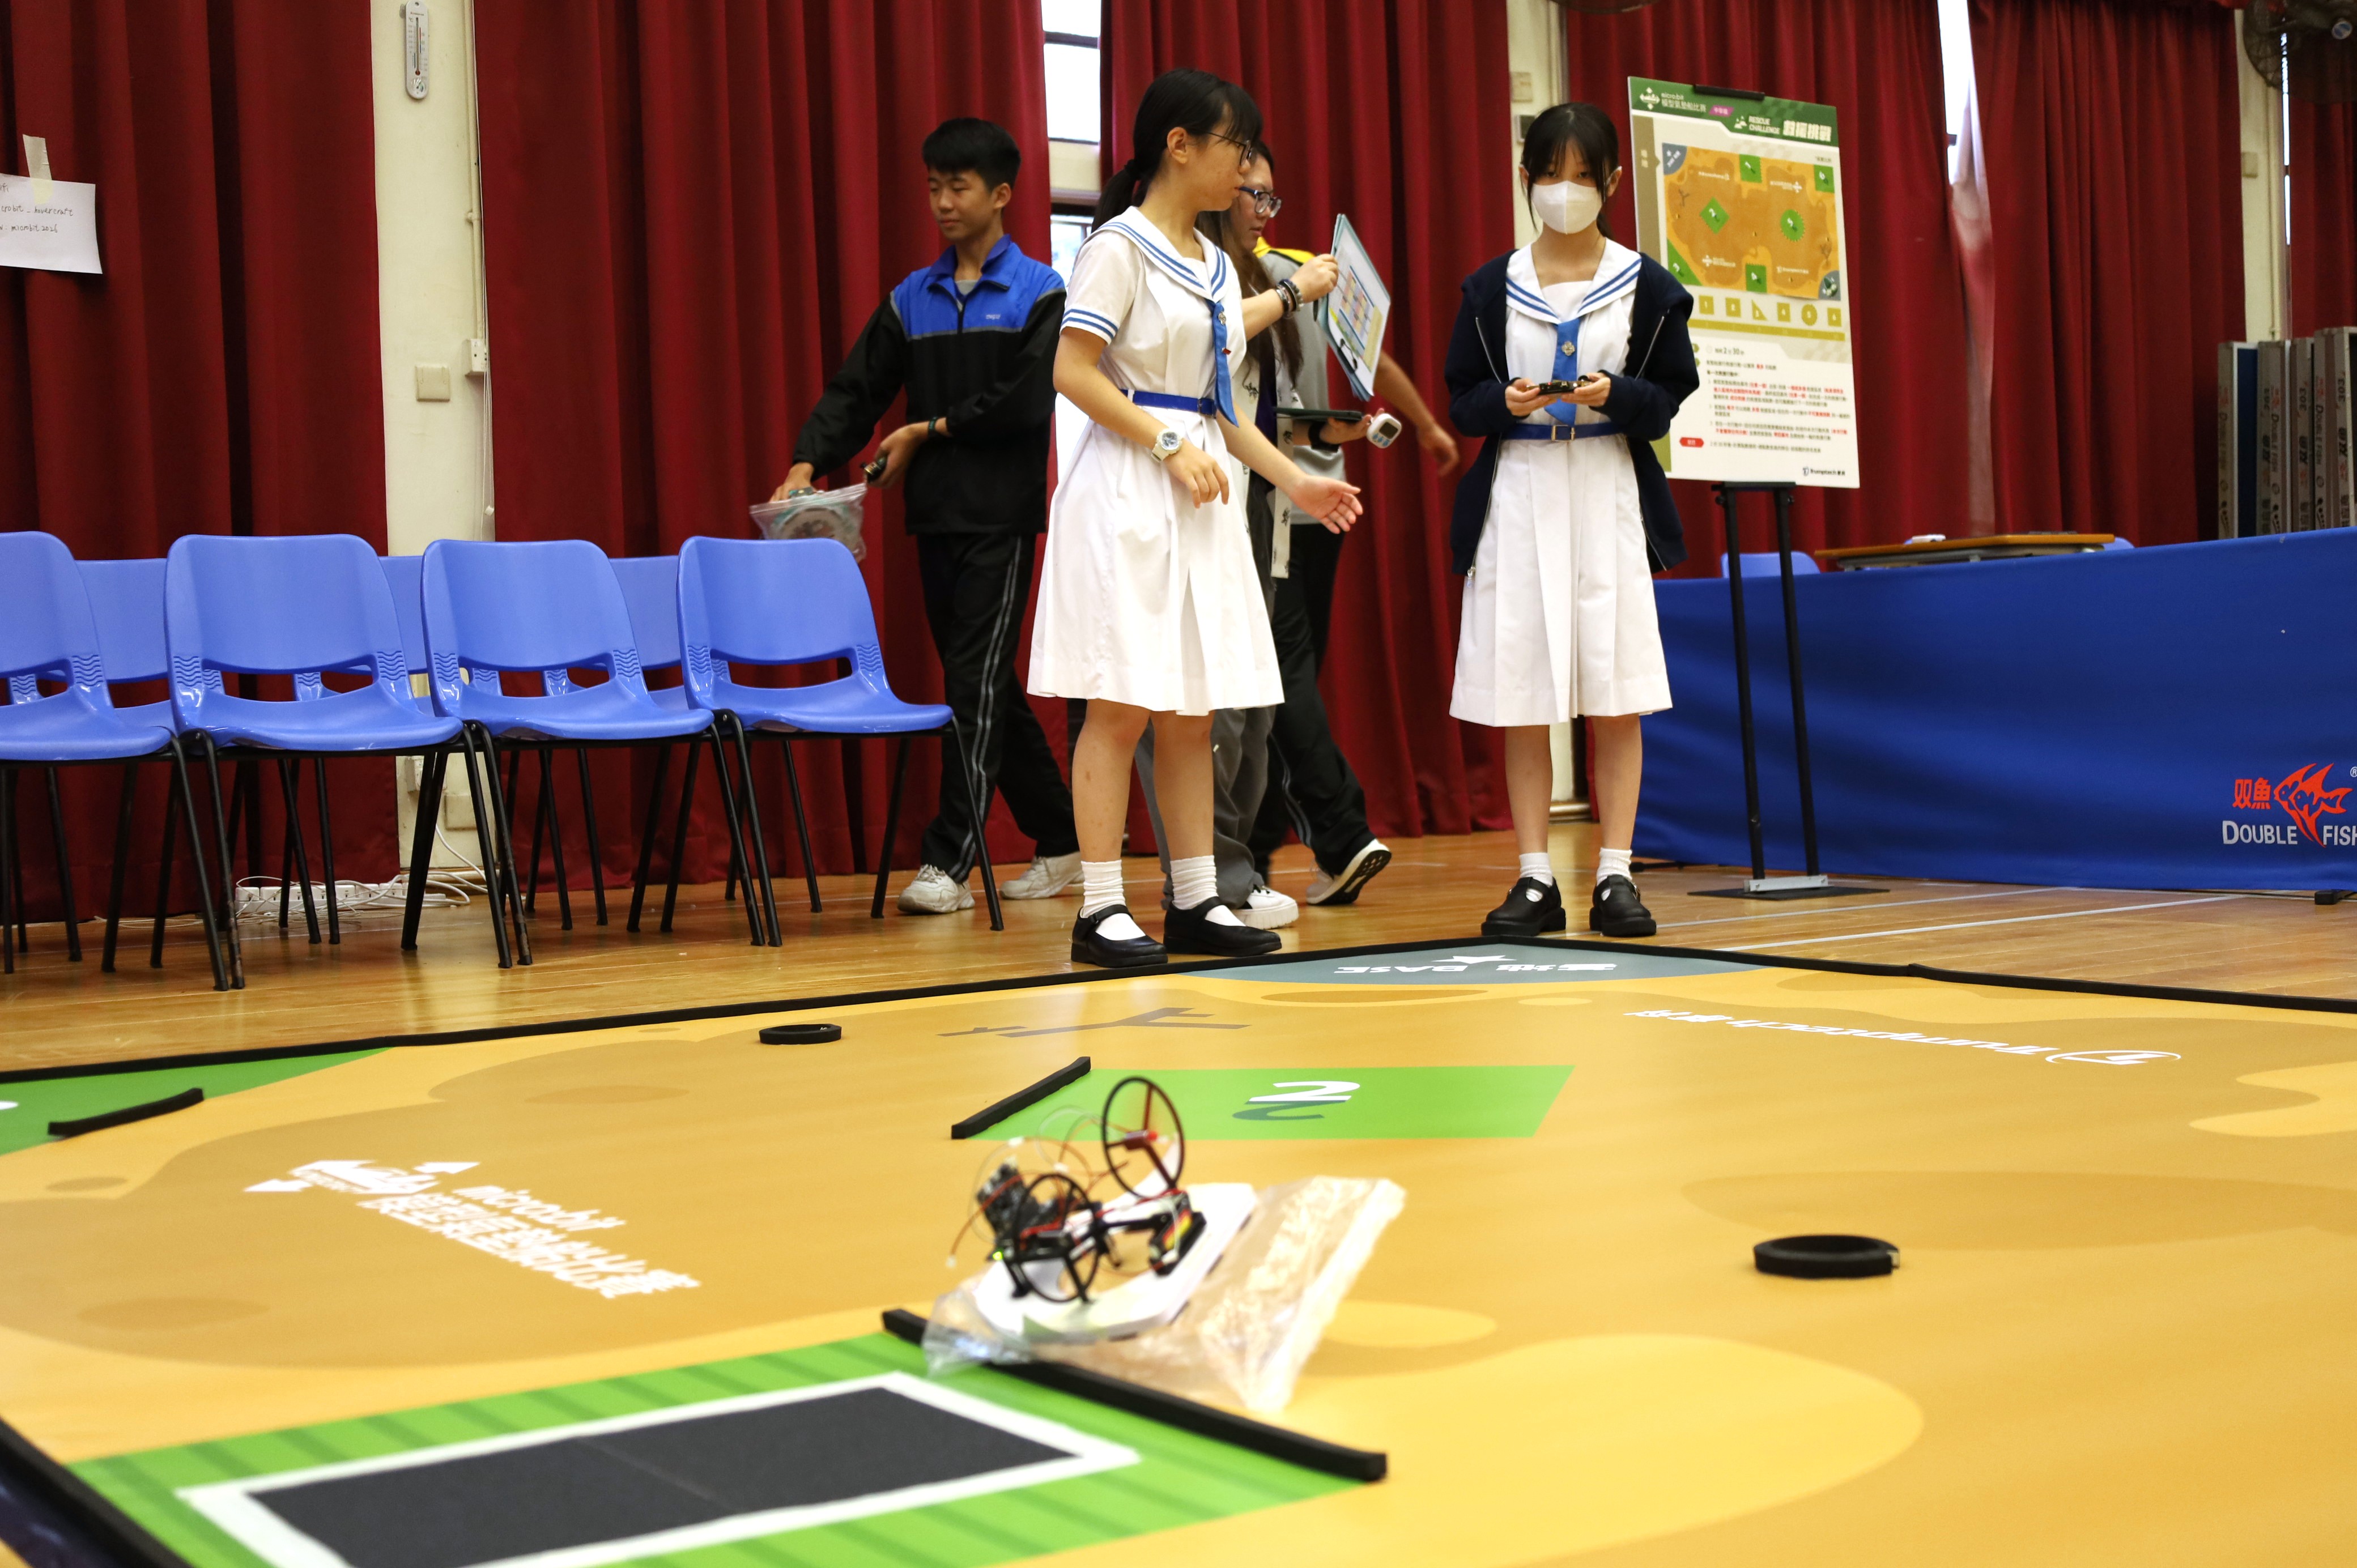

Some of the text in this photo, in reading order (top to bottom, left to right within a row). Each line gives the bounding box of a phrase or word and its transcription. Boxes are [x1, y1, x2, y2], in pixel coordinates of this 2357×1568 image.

[1748, 116, 1771, 125] RESCUE
[1749, 124, 1780, 135] CHALLENGE
[2222, 820, 2298, 845] DOUBLE
[1334, 965, 1467, 973] BASE
[1726, 1019, 2061, 1055] Trumptech
[1249, 1081, 1360, 1101] 2
